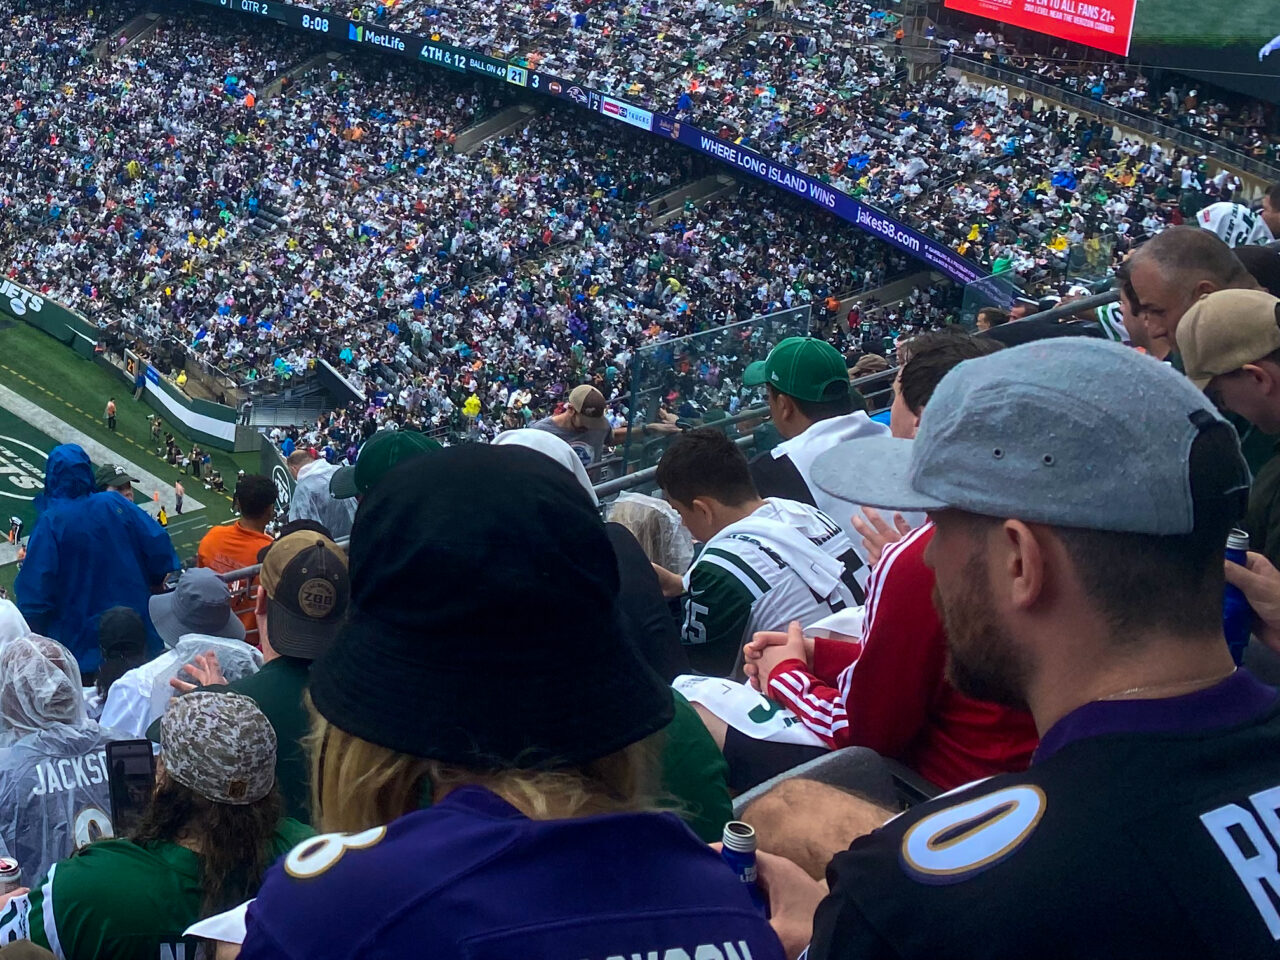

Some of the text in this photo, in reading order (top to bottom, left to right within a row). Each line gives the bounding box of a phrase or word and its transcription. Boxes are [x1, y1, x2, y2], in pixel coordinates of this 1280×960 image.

[261, 4, 268, 14] 2
[1077, 2, 1099, 20] FANS
[1100, 9, 1116, 22] 21+
[302, 16, 330, 32] 8:08
[365, 31, 406, 51] MetLife
[421, 45, 466, 68] 4TH & 12
[470, 58, 506, 77] BALL ON 49
[511, 68, 522, 82] 21
[532, 74, 539, 88] 3
[592, 100, 598, 110] 2
[700, 136, 836, 208] WHERE LONG ISLAND WINS
[856, 206, 920, 252] jakes58.com
